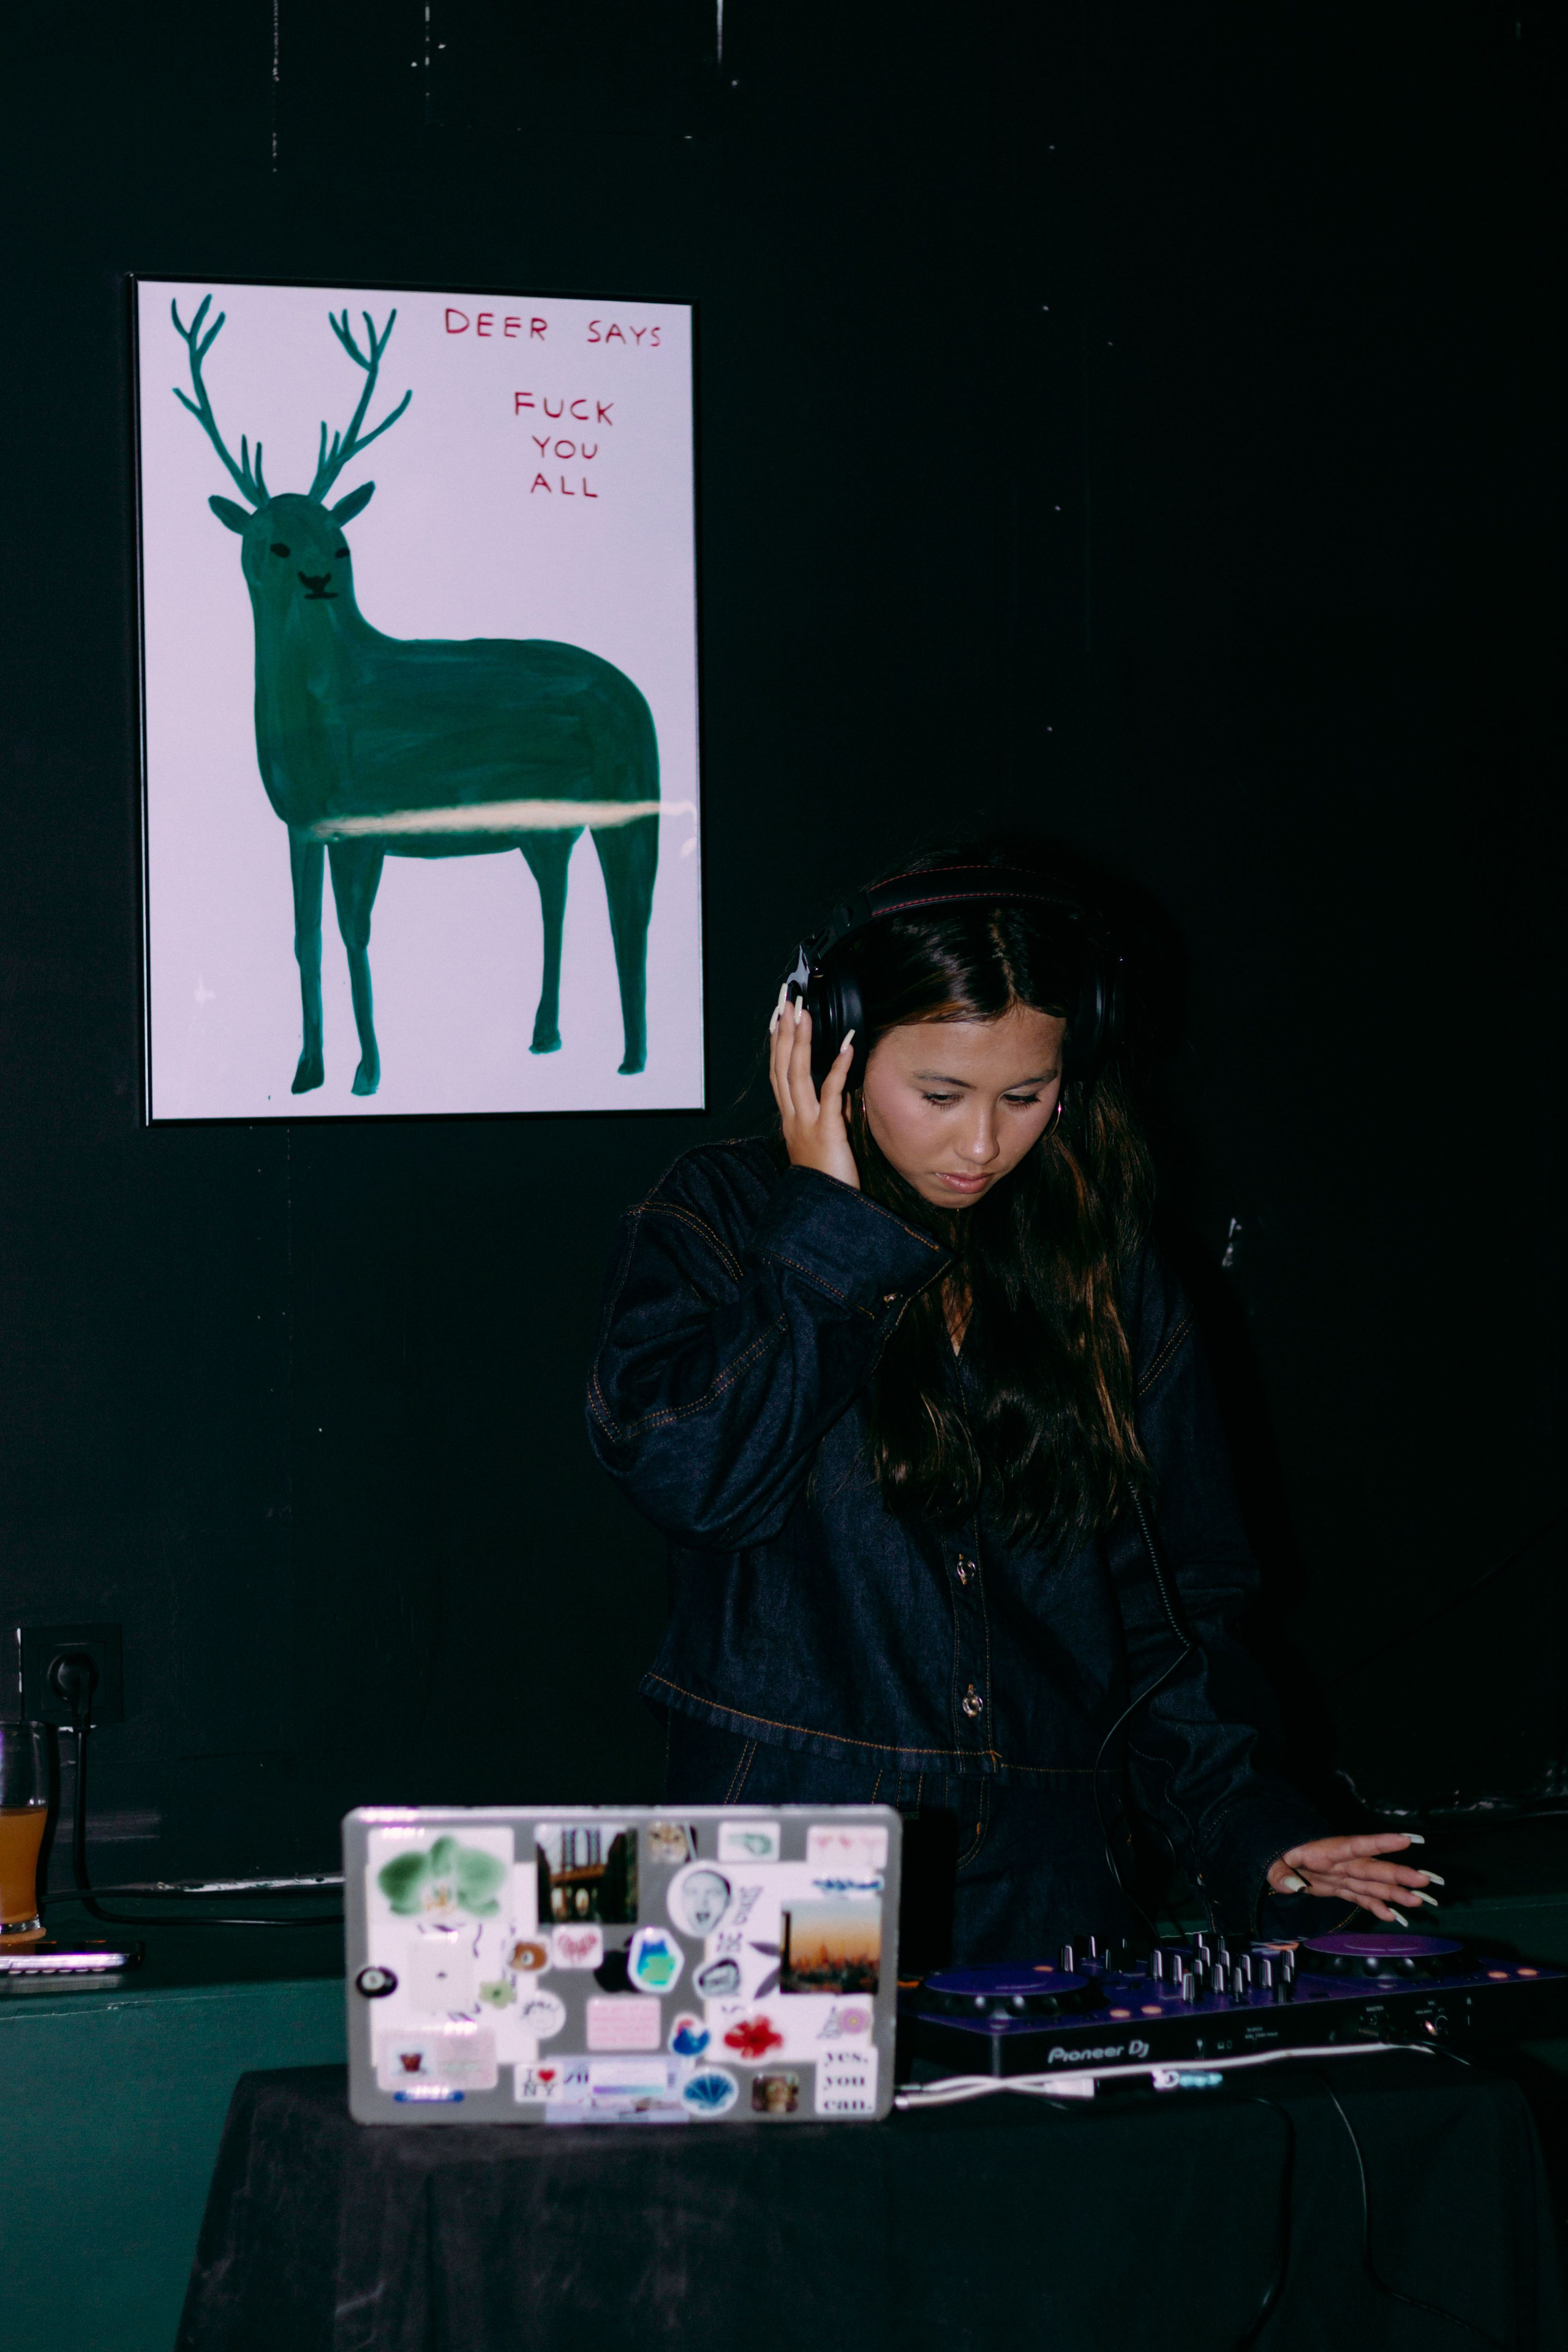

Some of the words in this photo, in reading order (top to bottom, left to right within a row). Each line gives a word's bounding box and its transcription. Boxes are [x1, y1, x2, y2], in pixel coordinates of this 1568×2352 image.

[445, 307, 548, 341] DEER
[586, 319, 662, 347] SAYS
[514, 390, 614, 426] FUCK
[531, 434, 598, 459] YOU
[530, 472, 599, 498] ALL
[1047, 2045, 1126, 2065] Pioneer
[823, 2076, 865, 2091] you
